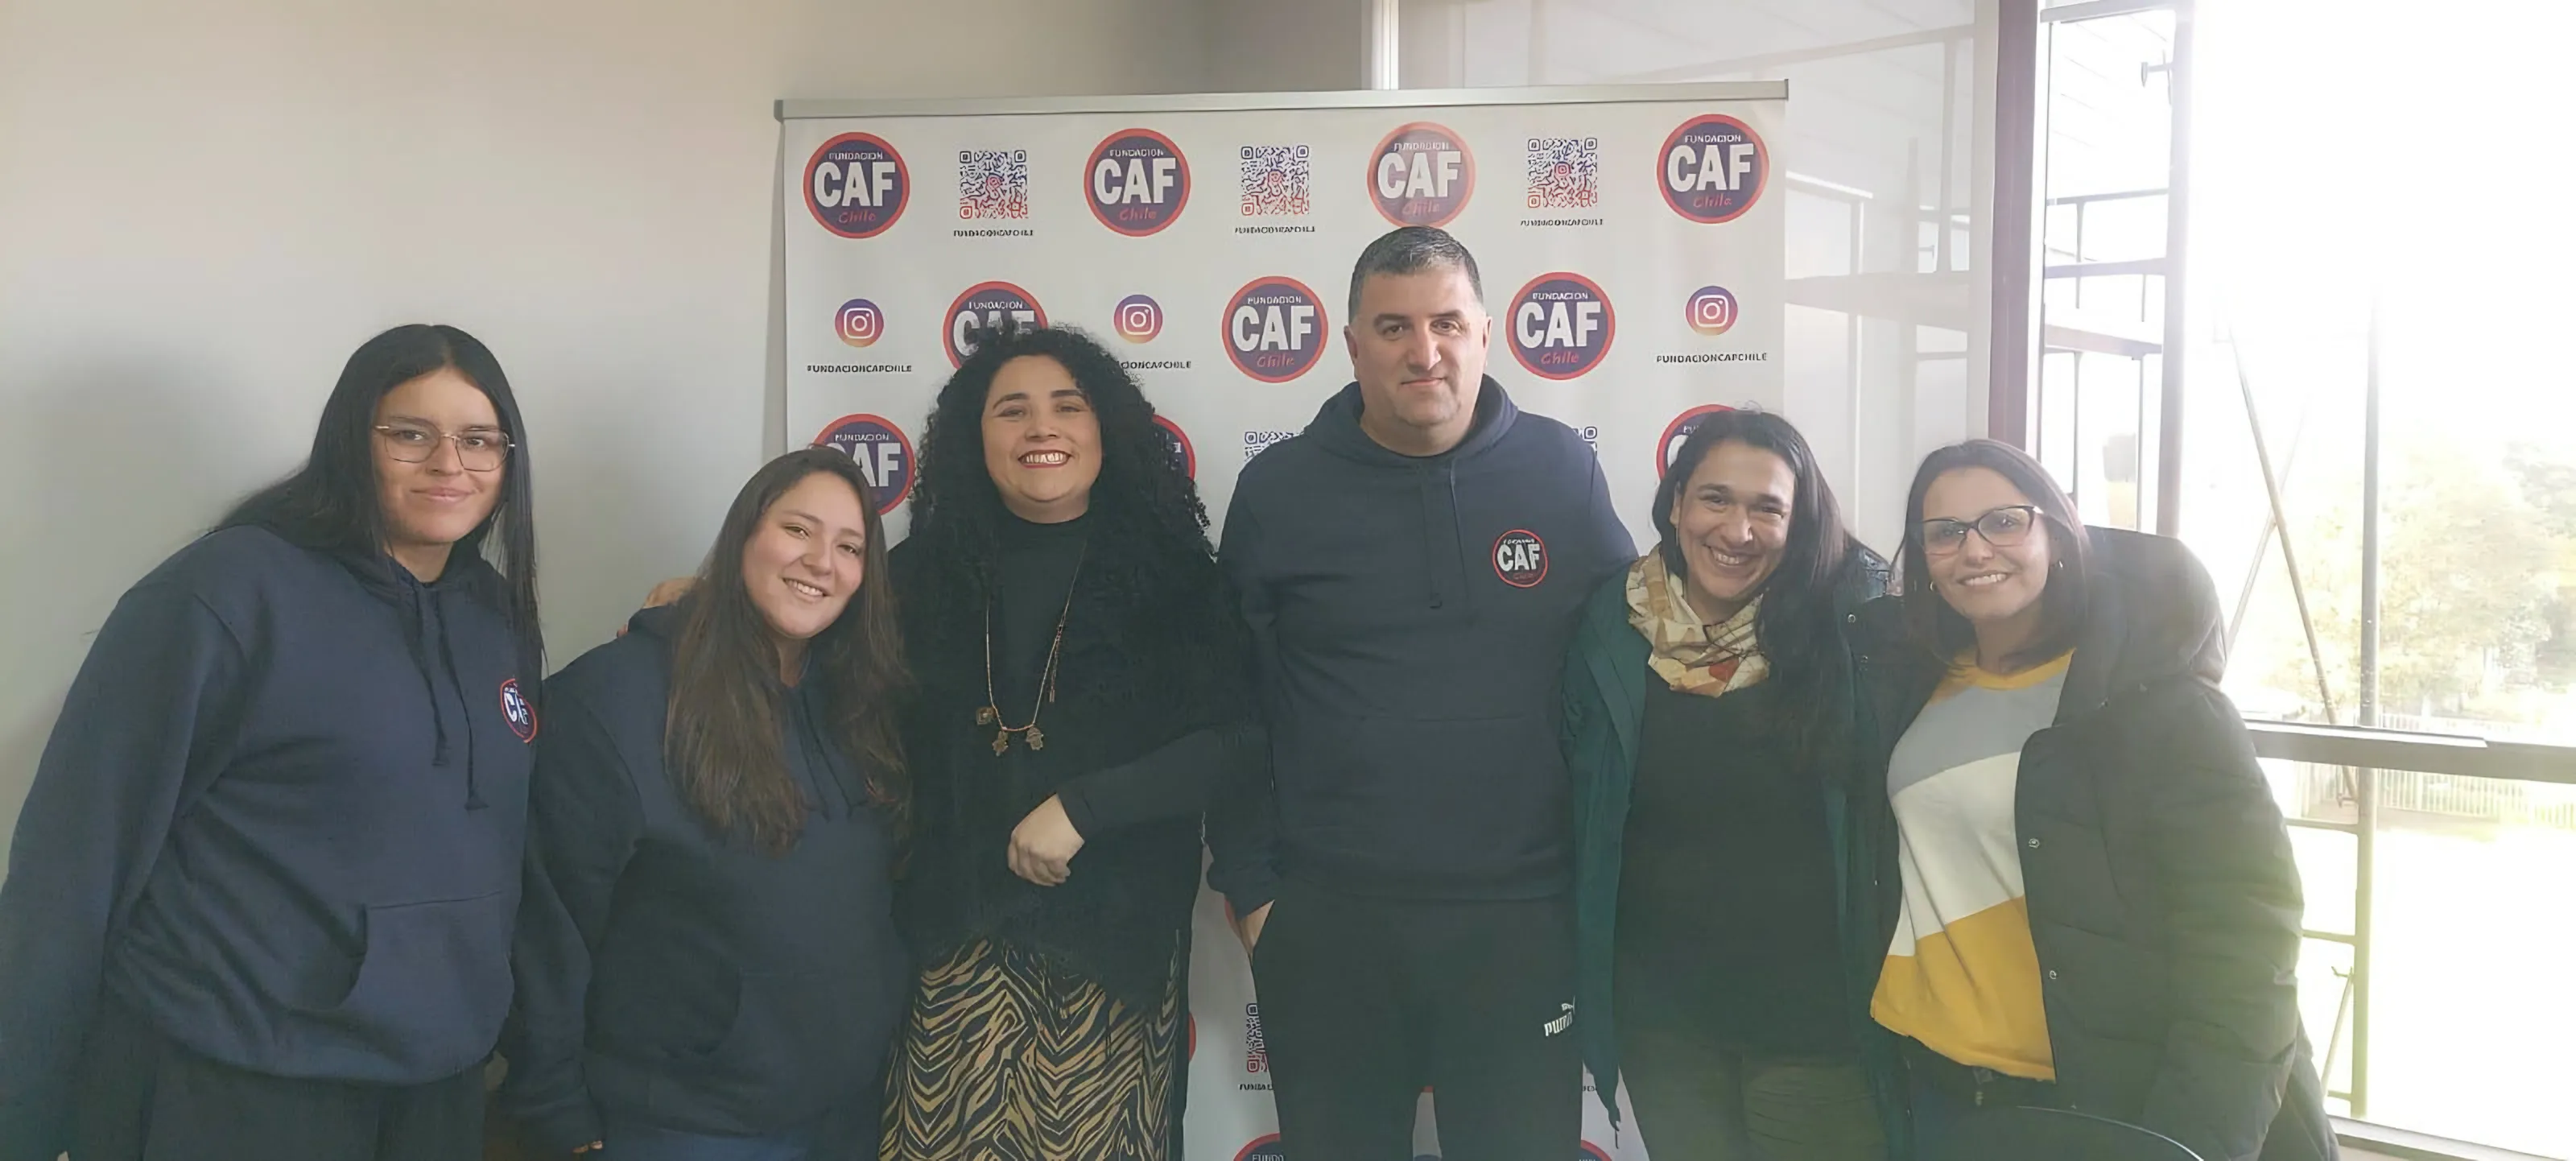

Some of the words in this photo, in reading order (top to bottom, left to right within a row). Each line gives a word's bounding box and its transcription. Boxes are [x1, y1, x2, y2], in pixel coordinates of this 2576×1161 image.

[1684, 134, 1741, 143] FUNDACION
[828, 151, 884, 160] FUNDACION
[1109, 148, 1164, 157] FUNDACION
[1667, 143, 1754, 192] CAF
[1094, 157, 1176, 205] CAF
[1377, 151, 1462, 199] CAF
[814, 161, 896, 208] CAF
[838, 210, 877, 224] Chile
[1118, 207, 1158, 221] Chile
[1247, 295, 1302, 304] FUNDACION
[1532, 292, 1588, 300] FUNDACION
[968, 301, 1024, 309] FUNDACION
[1232, 305, 1315, 352] CAF
[1516, 301, 1601, 349] CAF
[1257, 353, 1294, 367] Chile
[1541, 351, 1579, 365] Chile
[826, 442, 901, 487] AF
[1497, 543, 1541, 572] CAF
